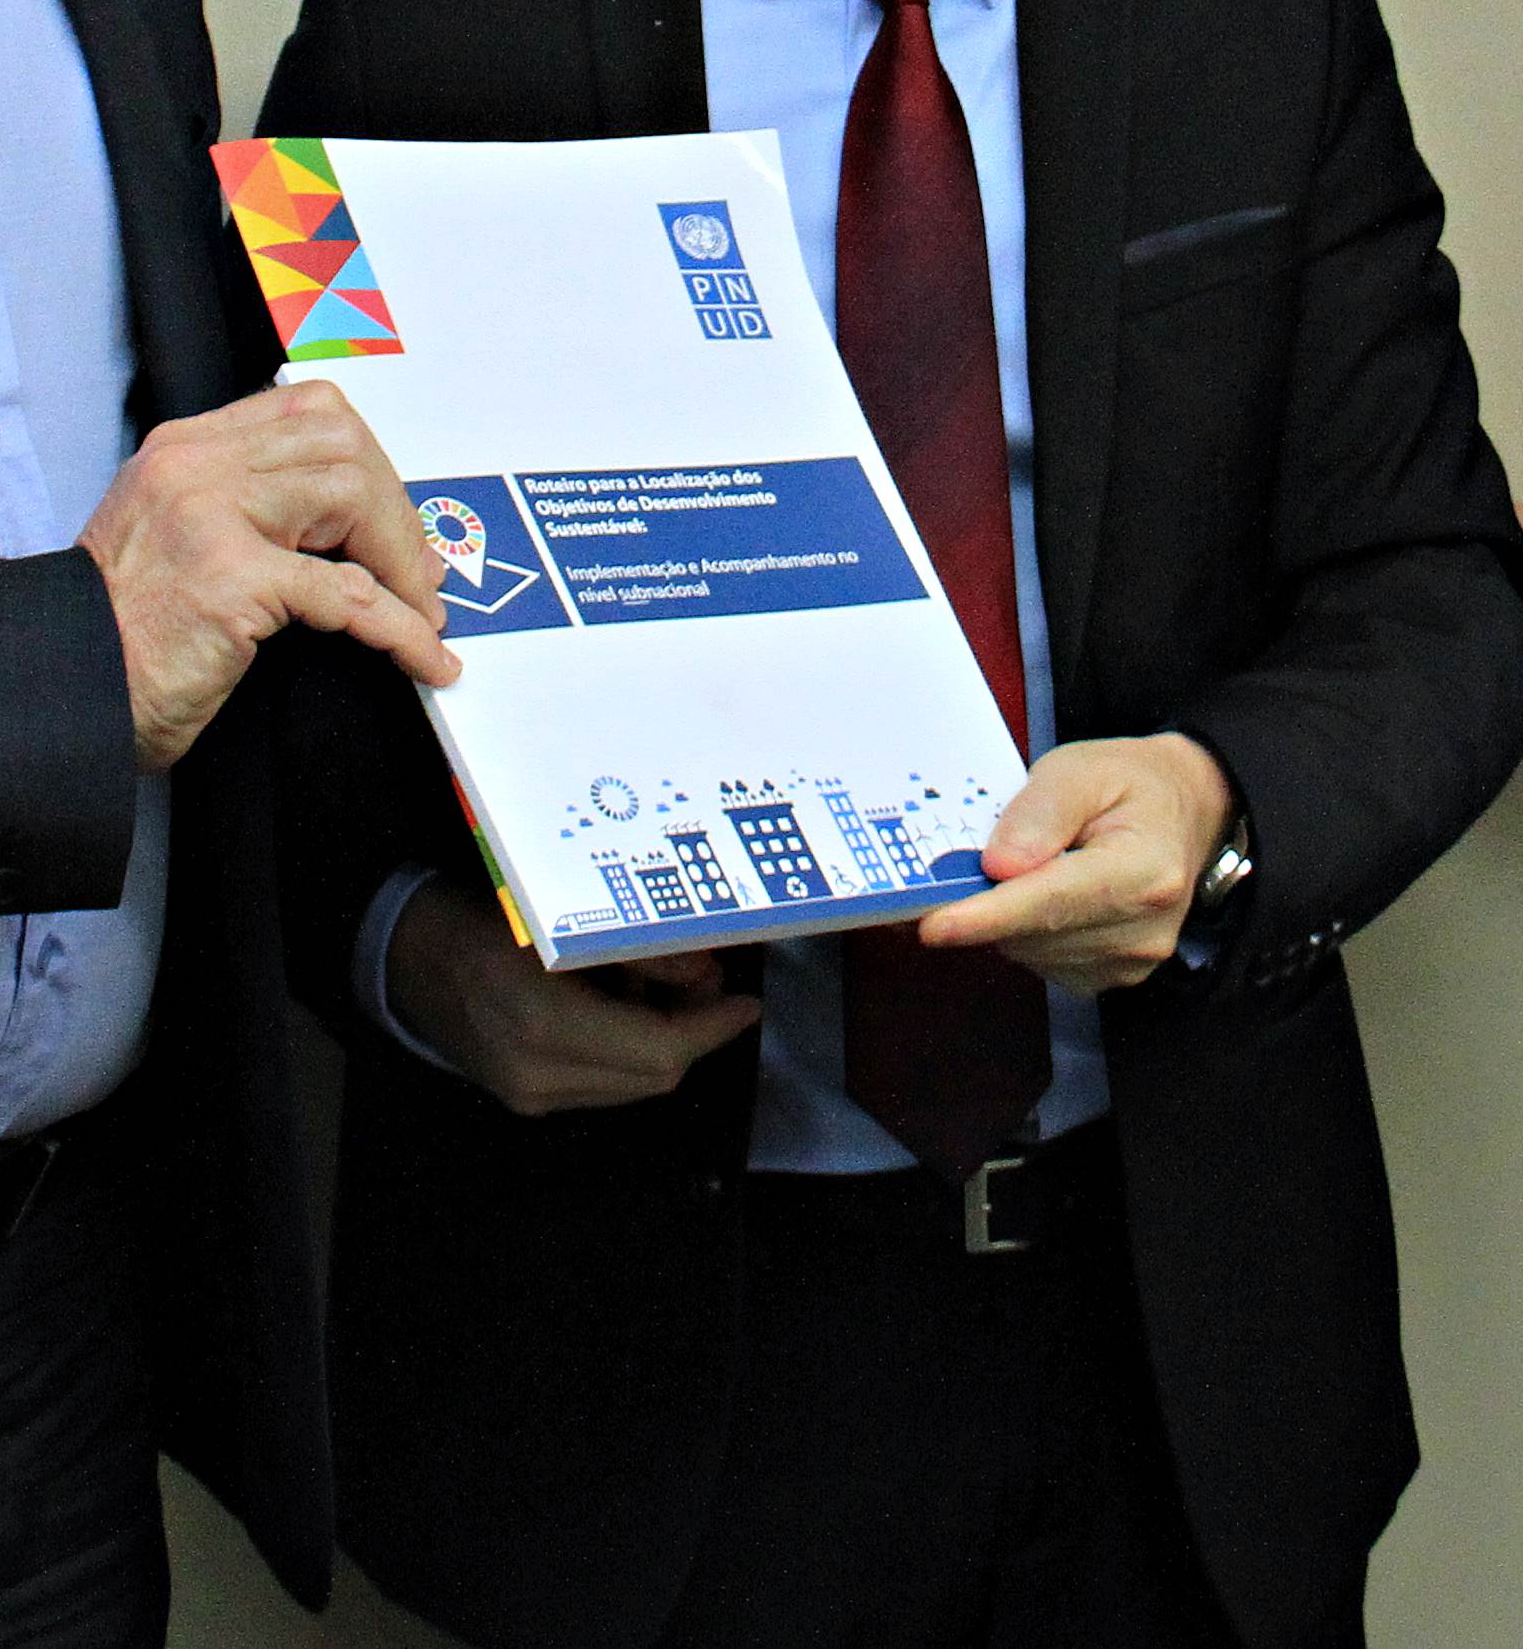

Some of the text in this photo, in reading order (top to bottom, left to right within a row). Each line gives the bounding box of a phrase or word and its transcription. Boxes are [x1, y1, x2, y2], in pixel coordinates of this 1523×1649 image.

[524, 469, 763, 495] Roteiro para a Localização dos
[535, 491, 777, 518] Objetivos de Desenvolvimento
[545, 517, 649, 538] Sustentável:
[565, 551, 860, 583] Implementação e Acompanhamento no
[578, 579, 711, 603] nível subnacional
